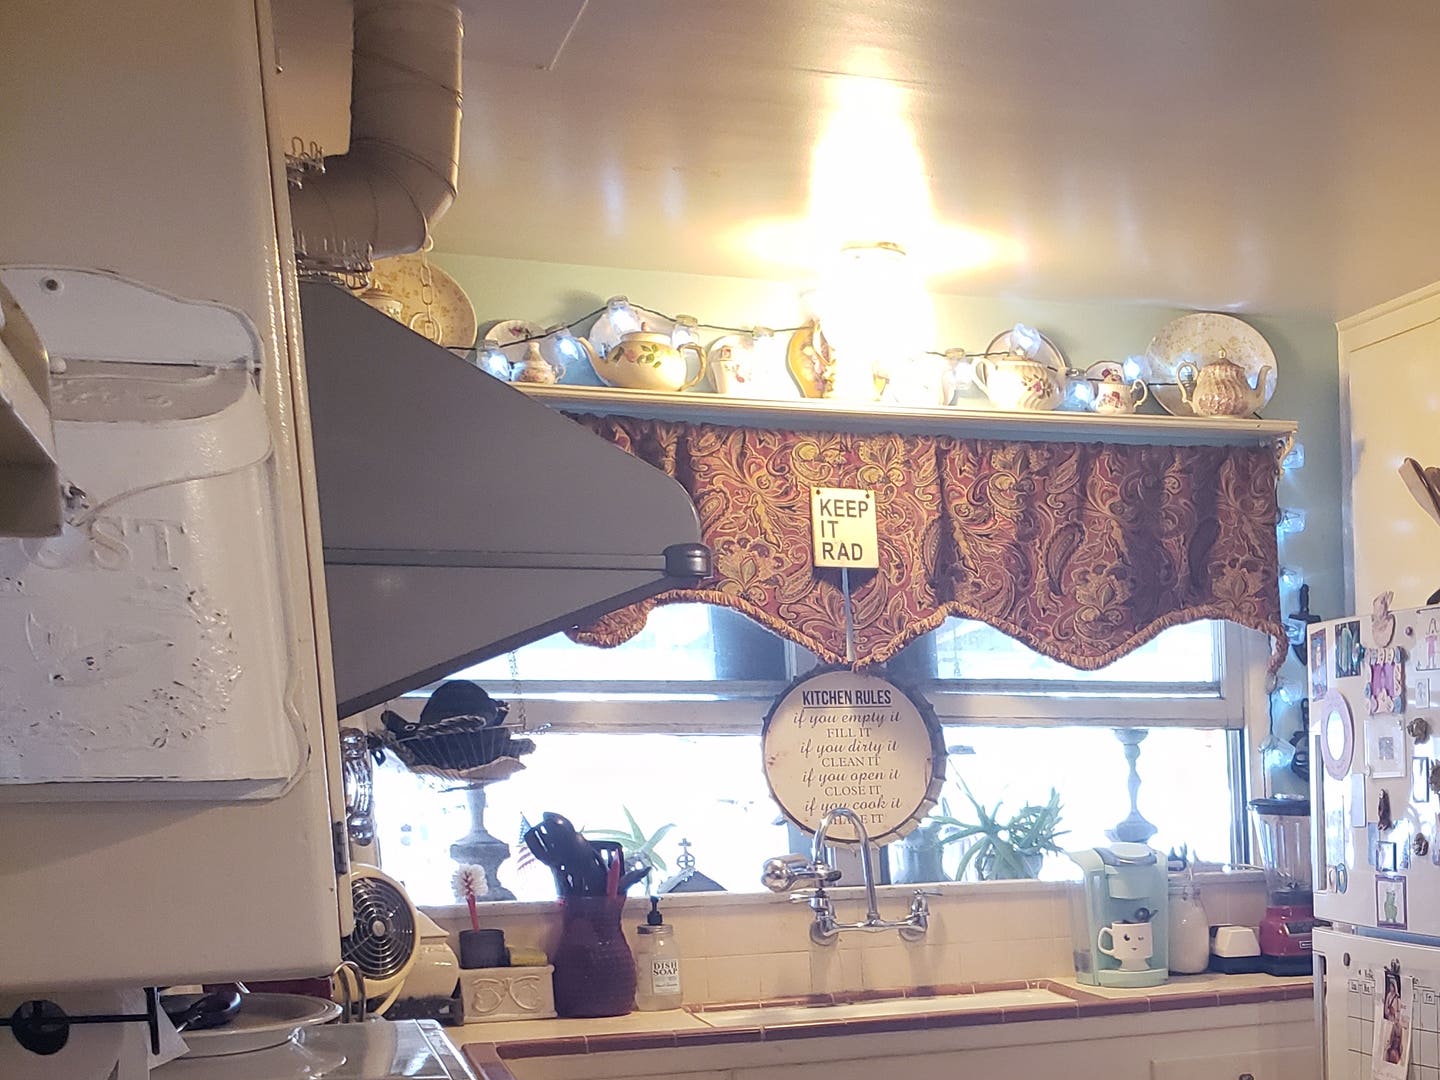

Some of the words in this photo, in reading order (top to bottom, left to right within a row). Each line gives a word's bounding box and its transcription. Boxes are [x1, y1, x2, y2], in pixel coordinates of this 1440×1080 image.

[820, 498, 869, 518] KEEP
[821, 520, 839, 538] IT
[822, 542, 863, 561] RAD
[802, 690, 853, 705] KITCHEN
[855, 689, 892, 705] RULES
[793, 709, 806, 728] if
[809, 714, 838, 728] you
[841, 712, 885, 727] empty
[890, 711, 901, 722] it
[827, 728, 856, 738] FILL
[860, 727, 872, 737] IT
[800, 739, 813, 758] if
[816, 744, 845, 758] you
[848, 739, 883, 756] dirty
[887, 740, 898, 752] it
[822, 757, 864, 767] CLEAN
[868, 756, 881, 766] IT
[802, 767, 815, 787] if
[818, 773, 847, 787] you
[850, 771, 885, 785] open
[889, 768, 901, 780] it
[824, 786, 866, 796] CLOSE
[869, 785, 882, 795] IT
[805, 797, 817, 816] if
[820, 802, 848, 816] you
[852, 794, 888, 809] cook
[891, 798, 902, 808] it
[871, 814, 884, 823] IT
[653, 961, 677, 970] DISH
[653, 968, 678, 976] SOAP
